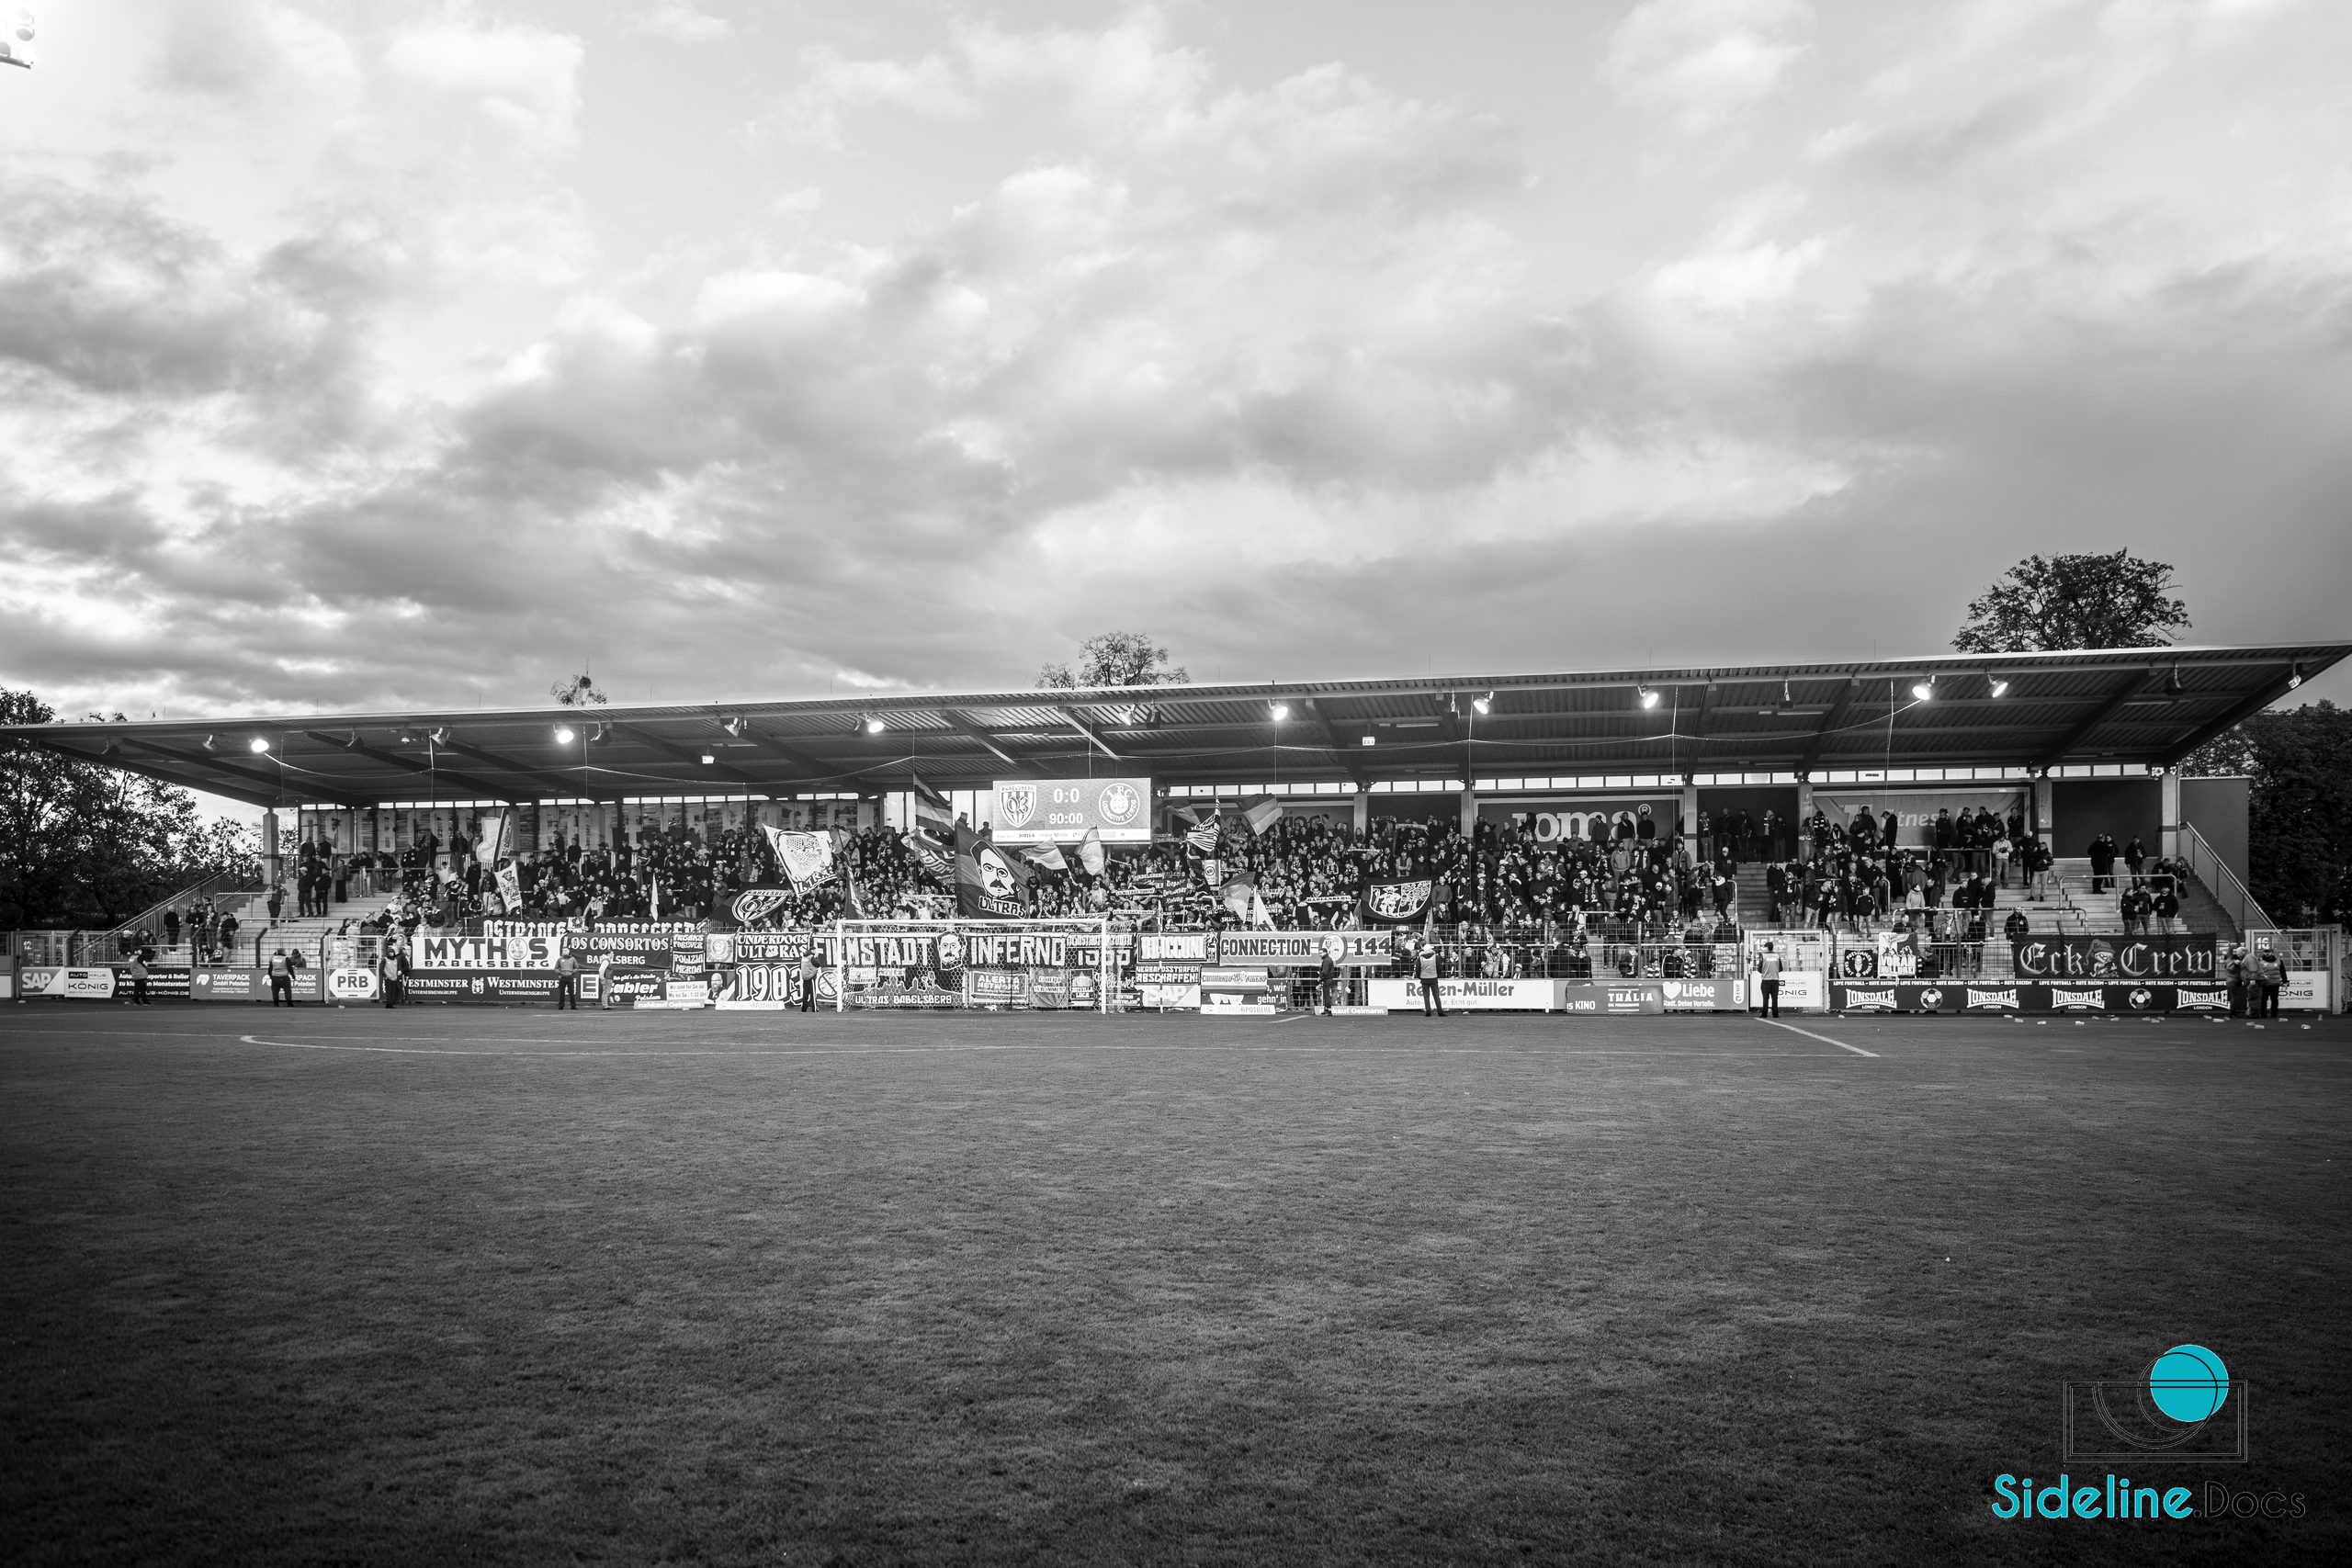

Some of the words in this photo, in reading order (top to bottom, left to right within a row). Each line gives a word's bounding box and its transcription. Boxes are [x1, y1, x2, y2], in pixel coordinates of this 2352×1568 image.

[1054, 788, 1080, 803] 0:0
[1116, 785, 1132, 799] FC
[1007, 796, 1029, 815] 03
[1049, 813, 1083, 824] 90:00
[978, 896, 1026, 919] ULTRAS
[590, 937, 669, 951] CONSORTOS
[738, 935, 808, 944] UNDERDOGS
[1221, 938, 1311, 956] CONNECTION
[1353, 937, 1391, 955] 144
[2256, 937, 2269, 949] 16
[424, 937, 548, 960] MYTHOS
[971, 936, 1065, 966] INFERNO
[586, 954, 646, 964] BABLSBERG
[674, 953, 704, 964] POLIZIA
[2020, 942, 2086, 976] Eck
[2120, 942, 2212, 976] Crew
[22, 972, 52, 988] SAP
[68, 981, 108, 989] KÖNIG
[337, 976, 369, 988] PRB
[736, 965, 803, 1001] 1903
[978, 974, 1020, 984] ALERTA
[1136, 973, 1198, 983] ABSCHAFFEN!
[1406, 981, 1515, 997] Reen-Müller
[1682, 984, 1715, 998] Liebe
[1576, 1000, 1595, 1010] KINO
[1846, 988, 1897, 1008] LONSDALE
[1967, 988, 2018, 1008] LONSDALE
[2052, 988, 2105, 1008] LONSDALE
[2177, 988, 2230, 1008] LONSDALE
